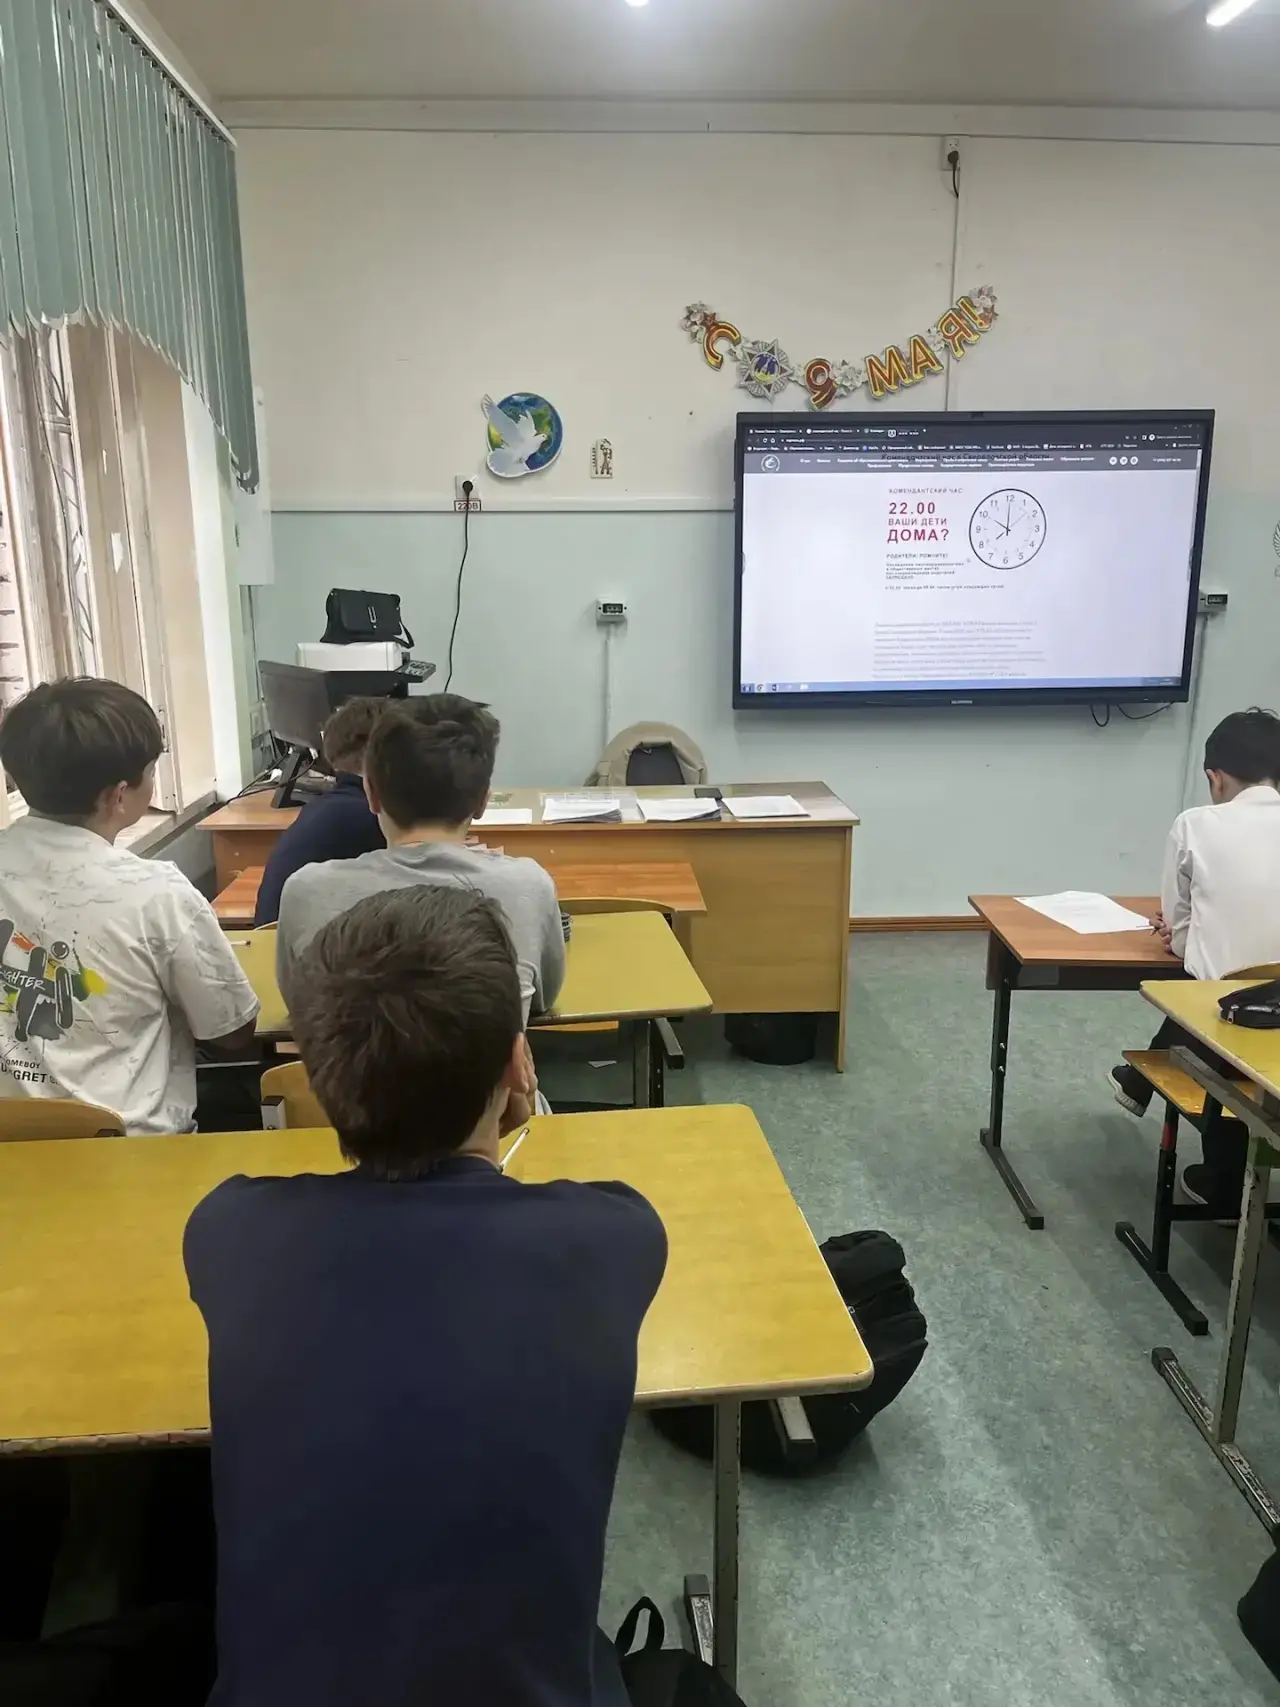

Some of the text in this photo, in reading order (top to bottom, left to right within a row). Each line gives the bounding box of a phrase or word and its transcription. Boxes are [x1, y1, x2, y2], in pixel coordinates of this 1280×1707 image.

[703, 295, 992, 411] С 9 МАЯ!
[888, 502, 935, 514] 22.00
[979, 510, 988, 518] 10
[888, 517, 947, 526] ВАШИ ДЕТИ
[887, 528, 949, 544] ДОМА?
[4, 971, 46, 991] GHTER
